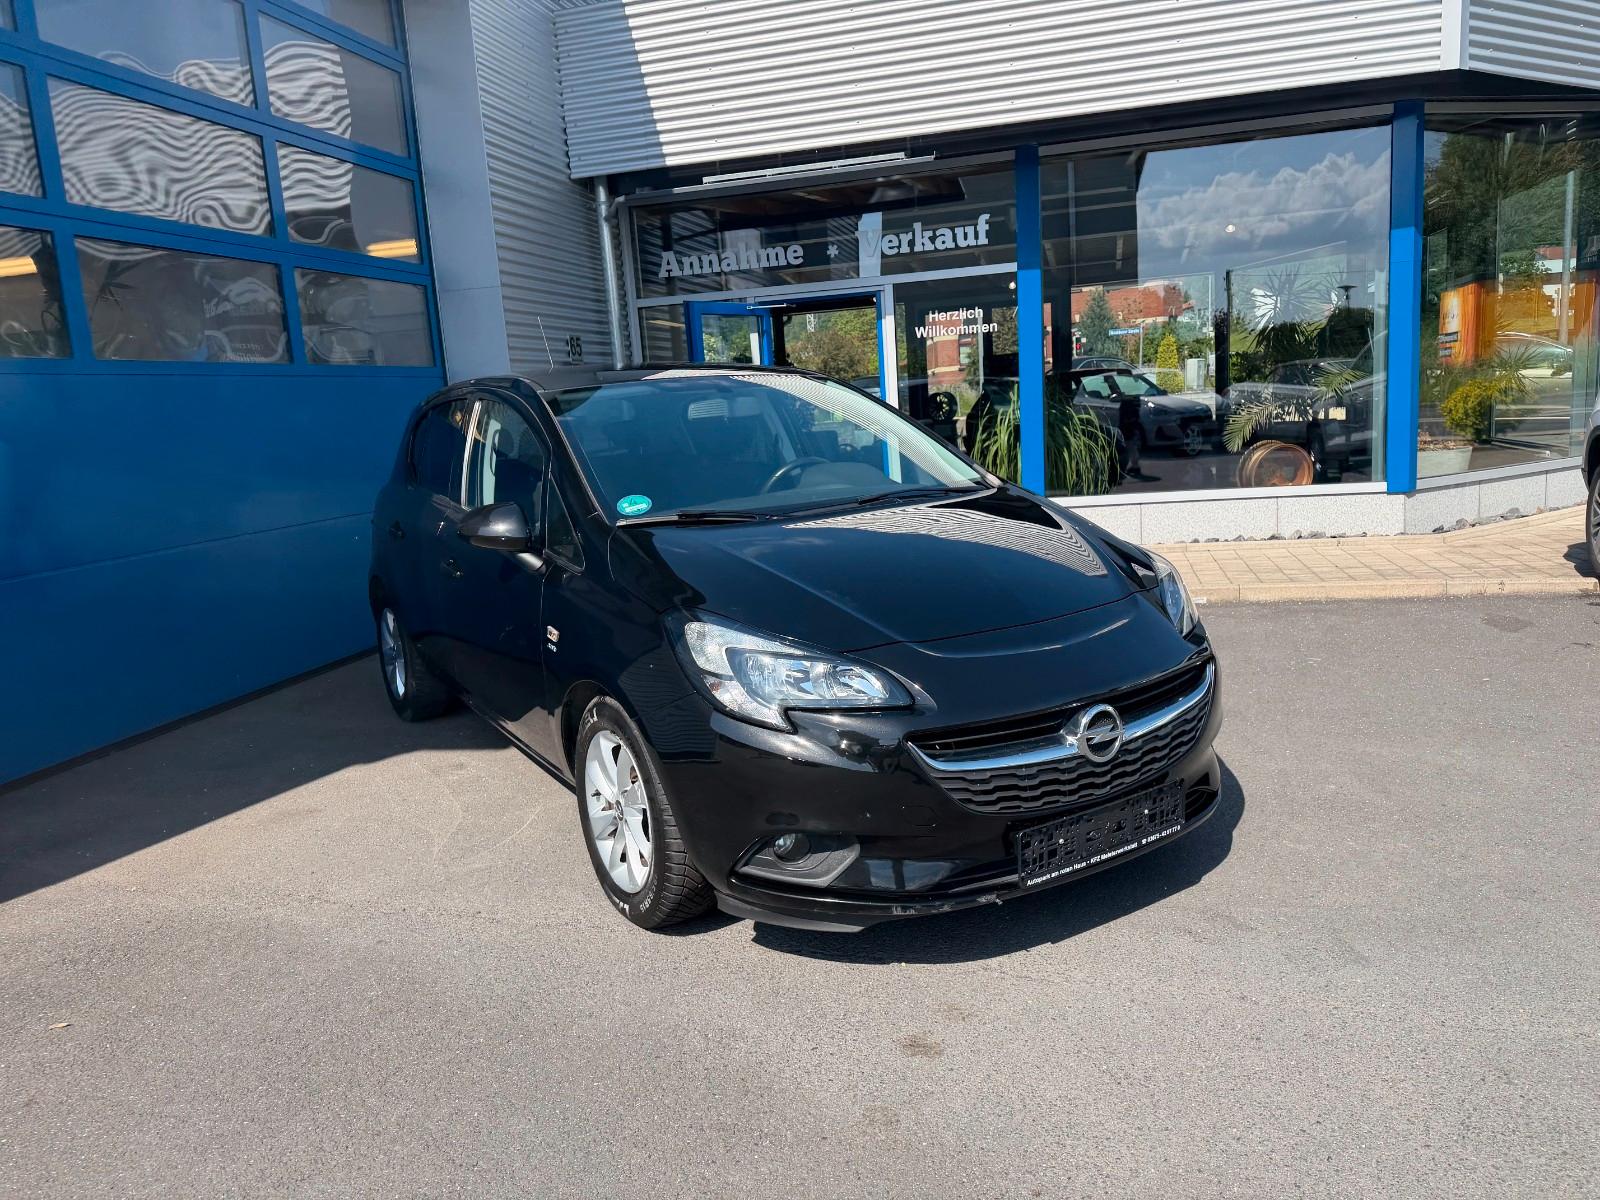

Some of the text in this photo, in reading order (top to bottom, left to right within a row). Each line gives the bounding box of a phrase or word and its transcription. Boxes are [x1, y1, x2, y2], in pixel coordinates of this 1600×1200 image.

[658, 213, 991, 278] Annahme Verkauf
[928, 306, 984, 322] Herzlich
[914, 322, 999, 339] Willkommen
